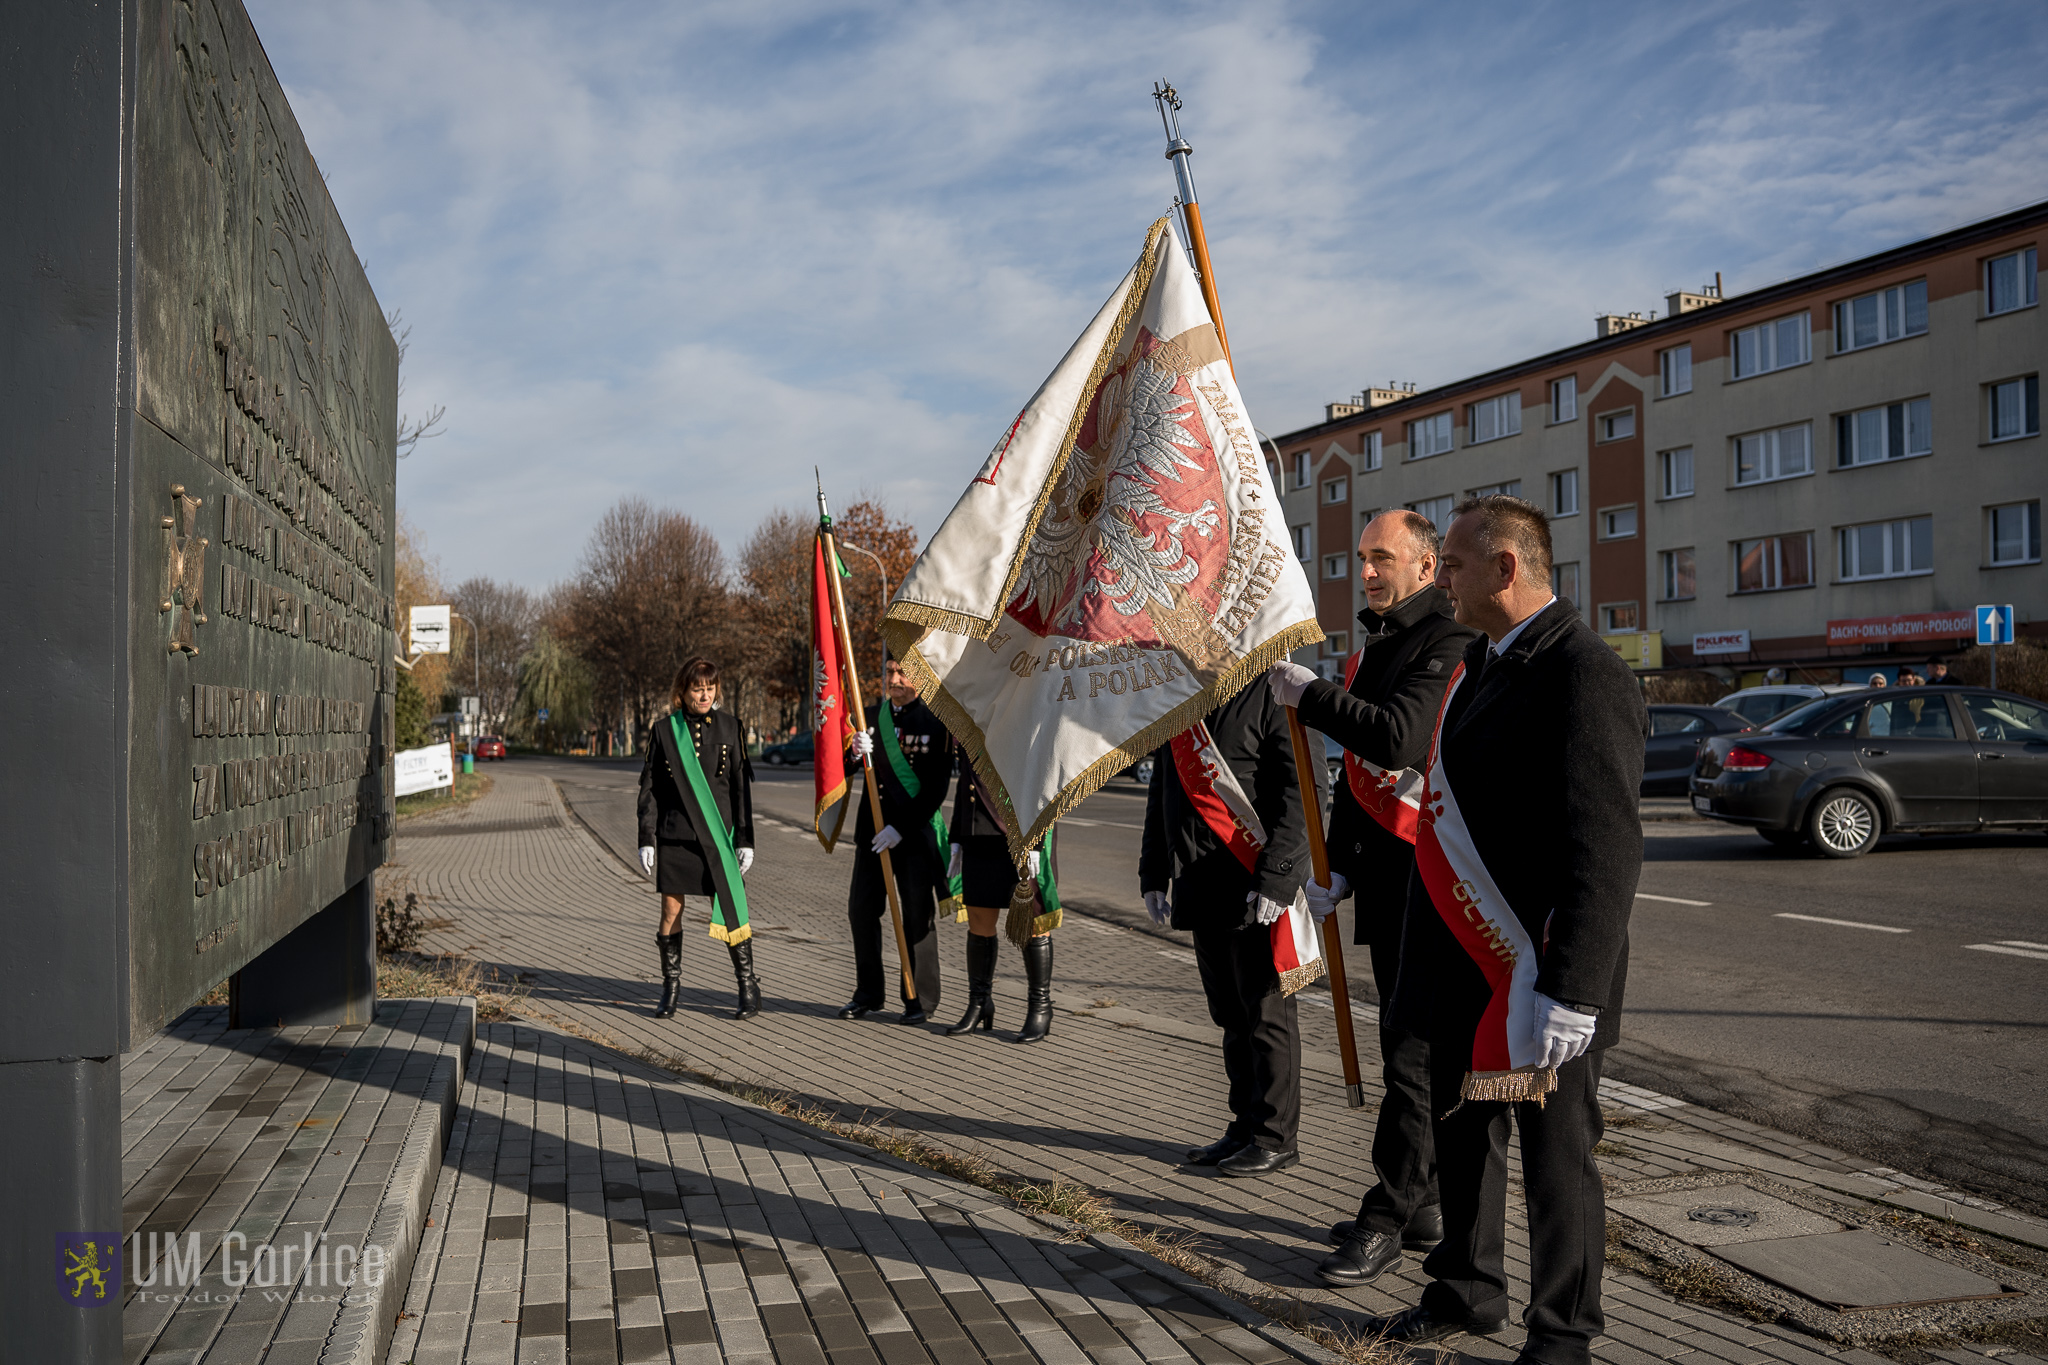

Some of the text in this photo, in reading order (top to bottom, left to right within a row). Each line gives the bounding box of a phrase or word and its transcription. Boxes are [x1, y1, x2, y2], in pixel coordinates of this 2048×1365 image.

[1056, 539, 1287, 702] A POLAK POLAKIEM
[1704, 634, 1743, 646] KUPIEC
[1041, 636, 1147, 673] POLSKA
[193, 684, 271, 738] LUDZIOM
[193, 763, 220, 820] ZA
